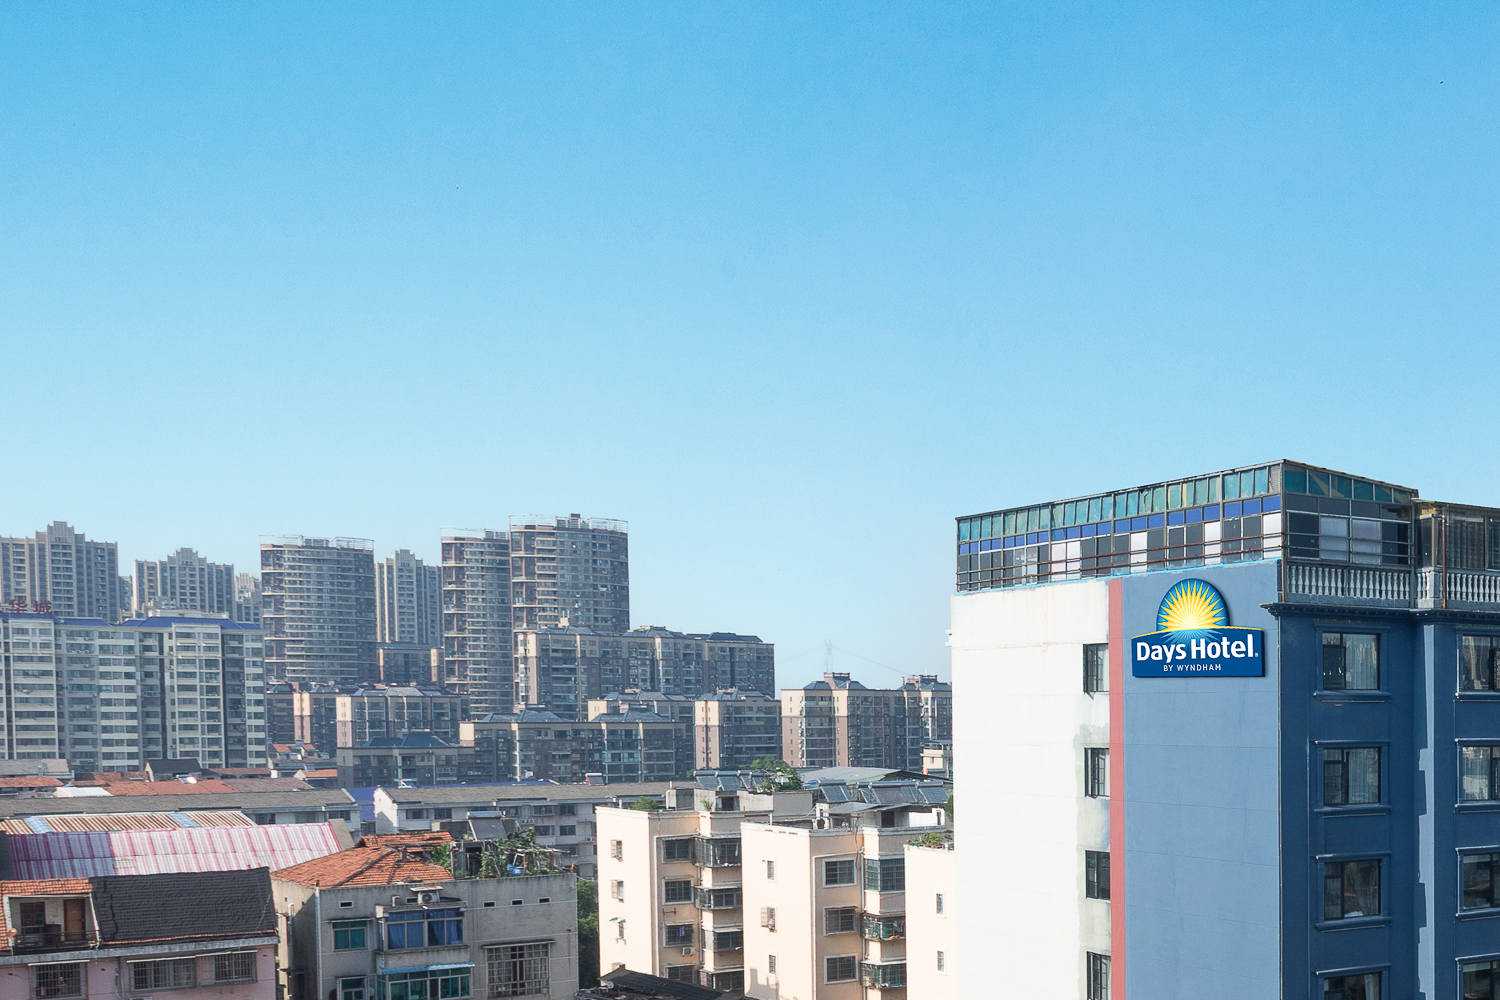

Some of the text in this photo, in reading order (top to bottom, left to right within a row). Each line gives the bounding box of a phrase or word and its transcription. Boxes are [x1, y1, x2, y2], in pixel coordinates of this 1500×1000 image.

[0, 599, 53, 614] 华城
[1136, 634, 1253, 663] Days Hotel
[1163, 663, 1222, 672] BY WYNDHAM
